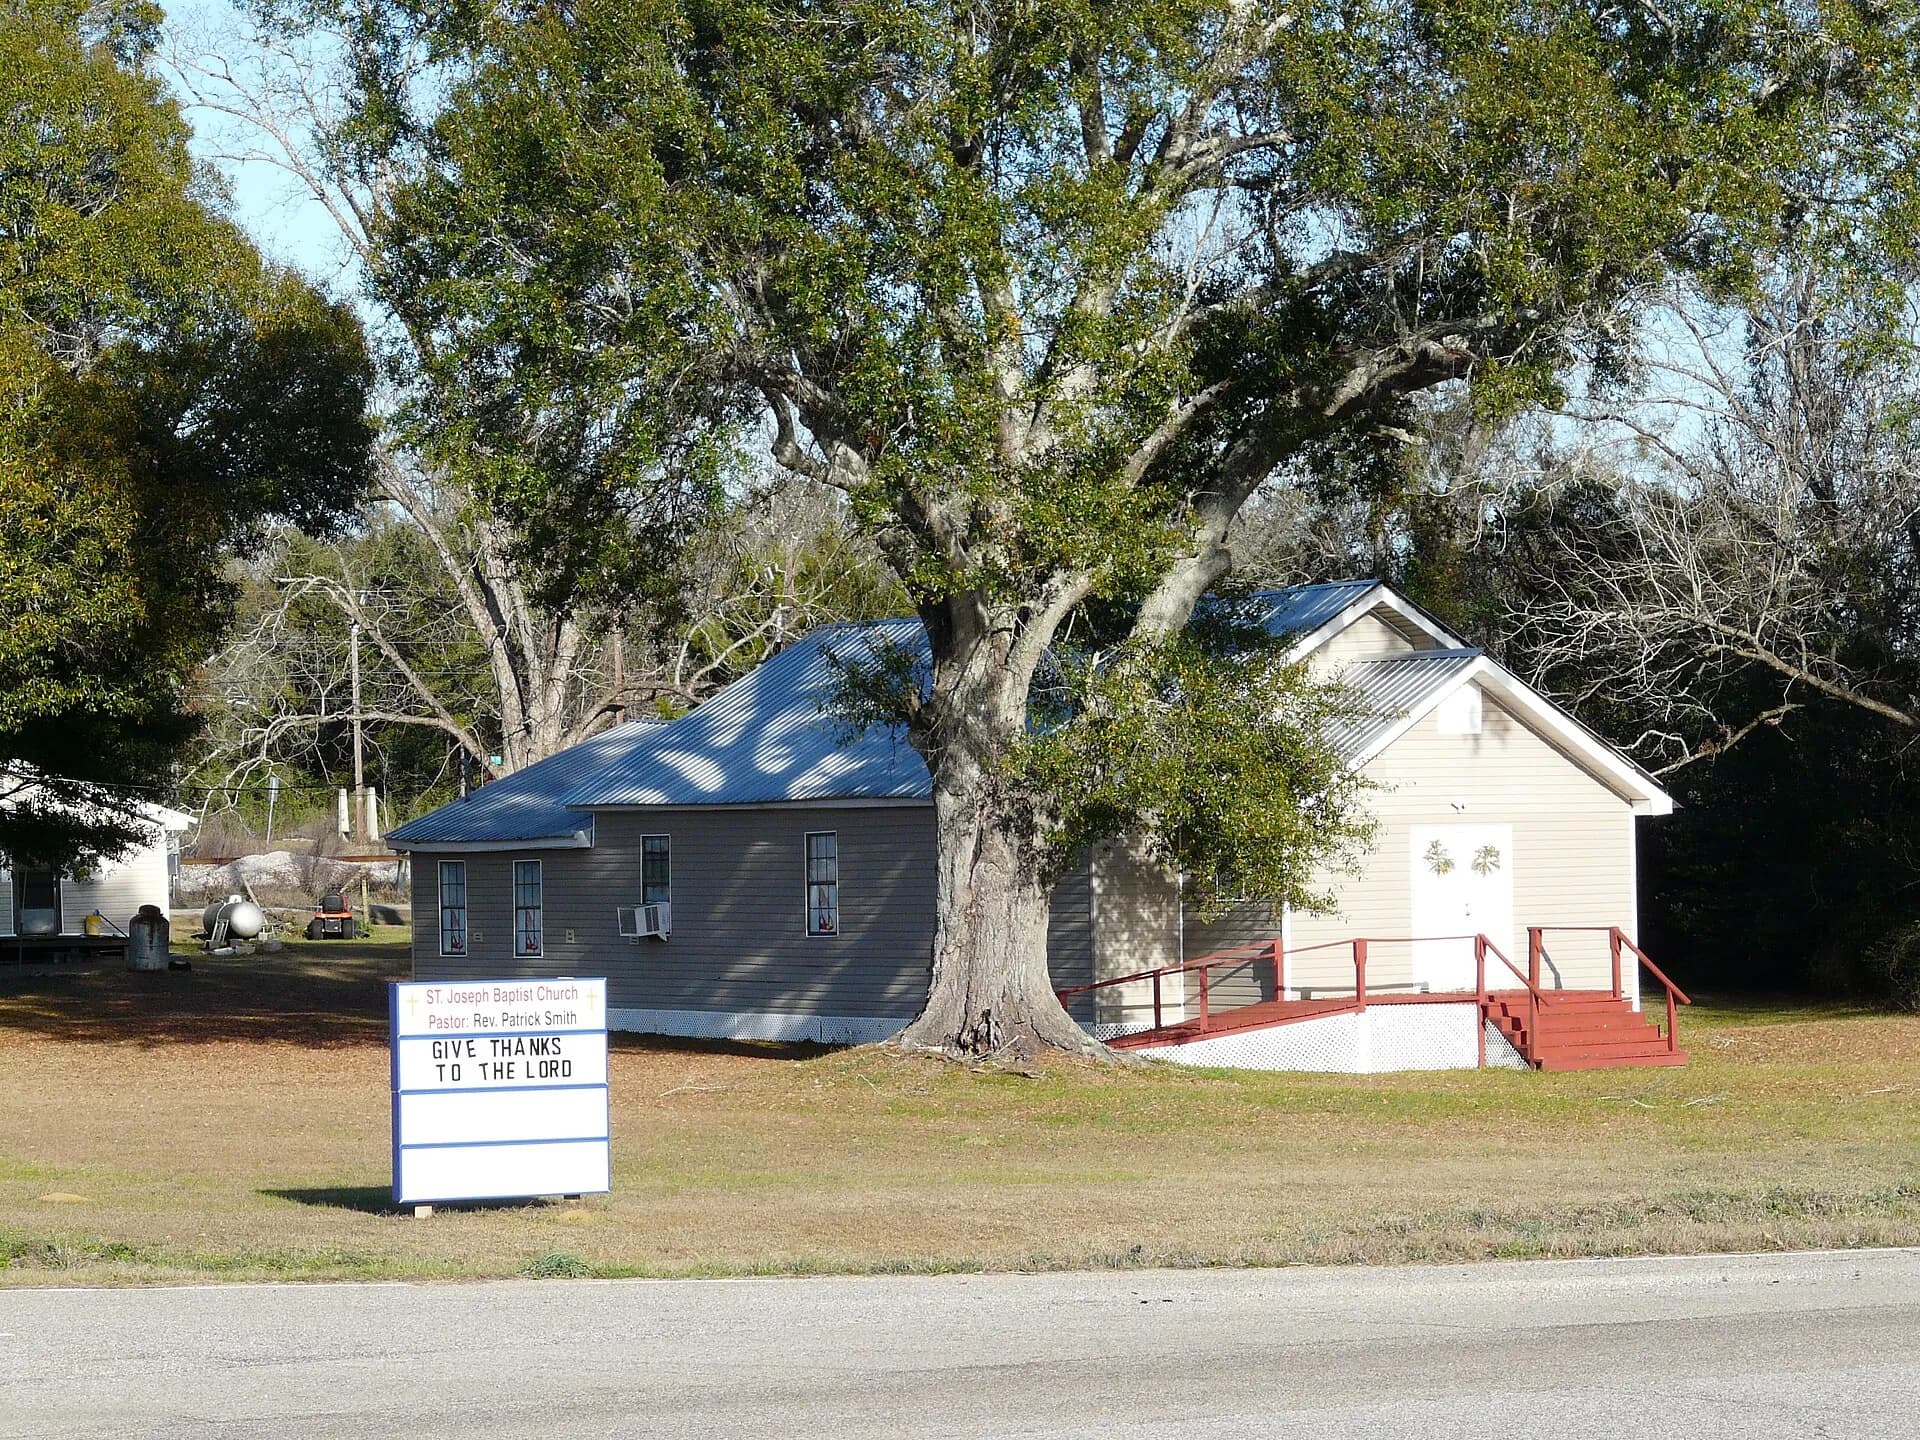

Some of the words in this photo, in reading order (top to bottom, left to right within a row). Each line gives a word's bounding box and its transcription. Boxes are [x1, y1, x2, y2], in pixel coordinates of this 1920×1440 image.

[426, 989, 443, 1005] ST.
[447, 987, 489, 1007] Joseph
[493, 987, 534, 1006] Baptist
[537, 985, 578, 1002] Church
[429, 1014, 469, 1029] Pastor:
[473, 1013, 498, 1028] Rev.
[502, 1012, 541, 1027] Patrick
[545, 1011, 577, 1025] Smith
[432, 1039, 477, 1059] GIVE
[490, 1037, 561, 1057] THANKS
[436, 1064, 461, 1082] TO
[479, 1062, 515, 1081] THE
[526, 1060, 572, 1079] LORD
